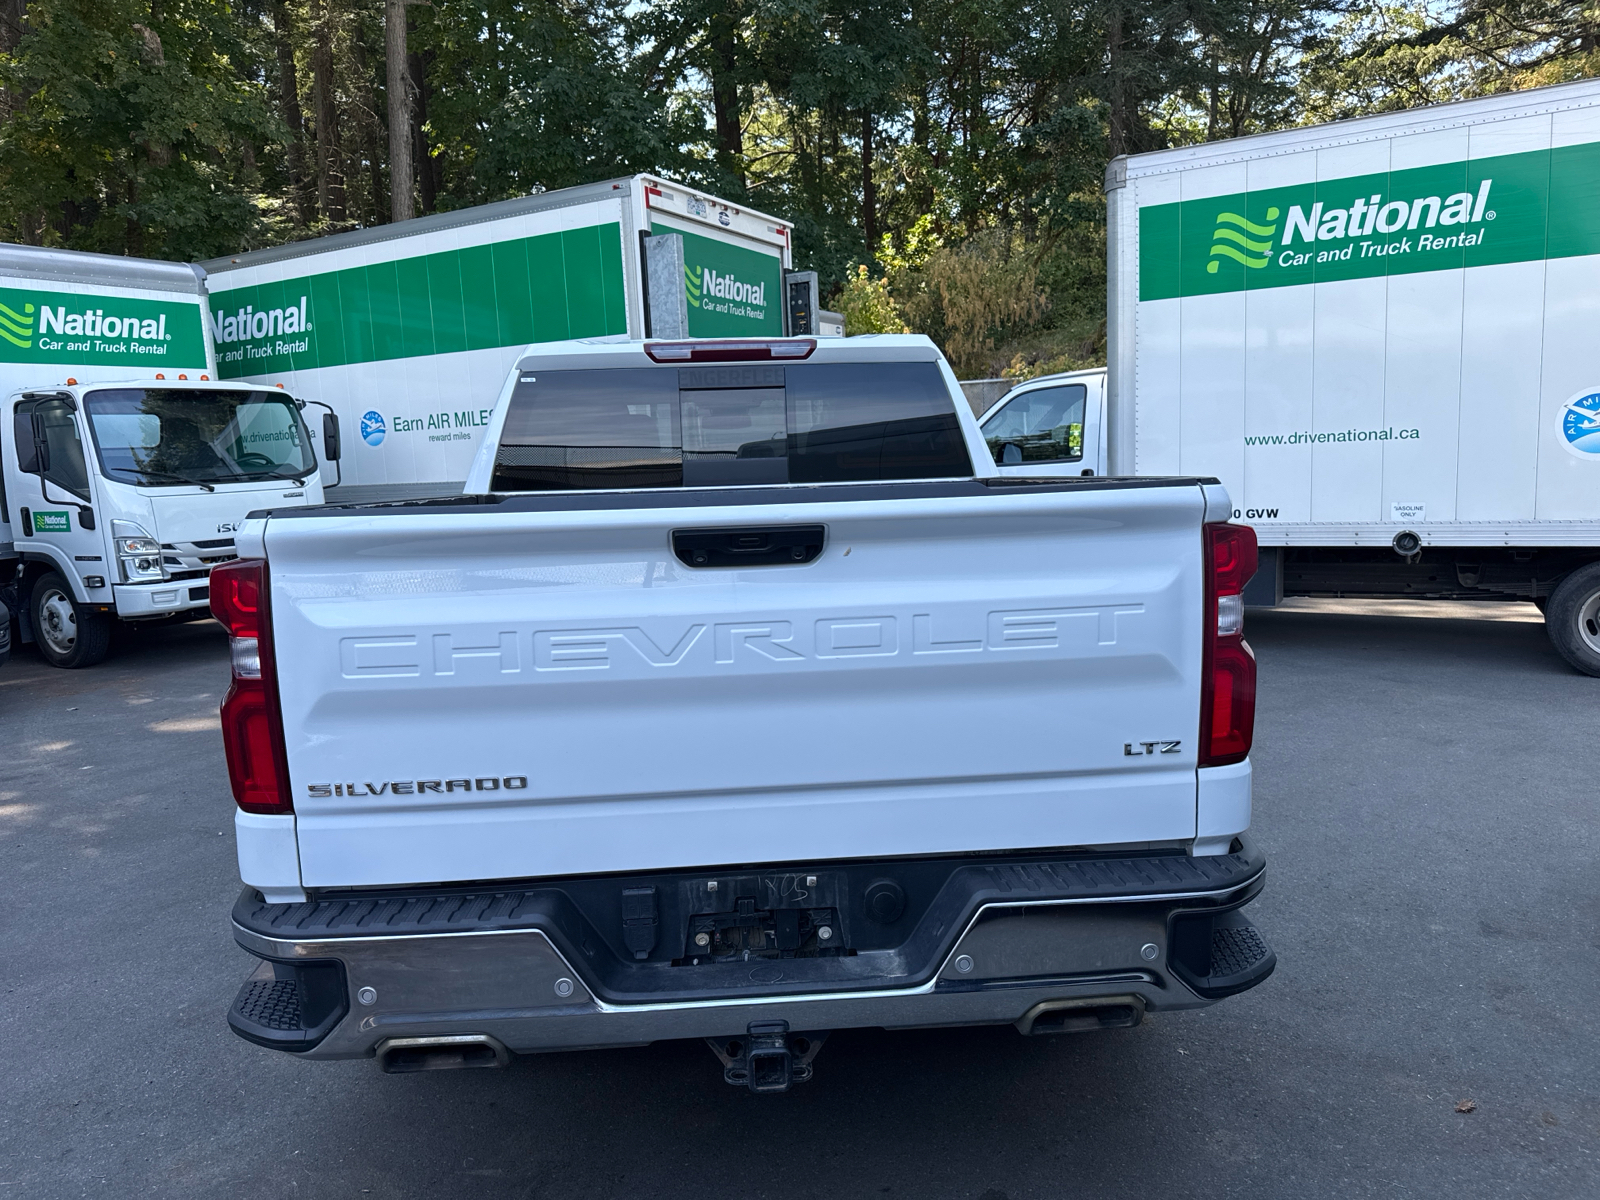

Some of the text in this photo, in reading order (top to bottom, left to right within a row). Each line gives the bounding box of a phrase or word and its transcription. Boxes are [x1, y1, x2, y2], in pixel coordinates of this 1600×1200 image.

[1278, 228, 1485, 267] Car and Truck Rental
[702, 298, 765, 320] Car and Truck Rental
[39, 337, 167, 355] Car and Truck Rental
[215, 337, 309, 363] ar and Truck Rental
[393, 416, 424, 432] Earn
[427, 412, 450, 430] AIR
[1567, 414, 1577, 435] AIR
[428, 431, 471, 442] reward miles
[1244, 427, 1420, 446] www.drivenational.ca
[1246, 508, 1279, 519] GVW
[339, 603, 1145, 679] CHEVROLET
[1123, 740, 1182, 757] LTZ
[307, 774, 528, 798] SILVERADO
